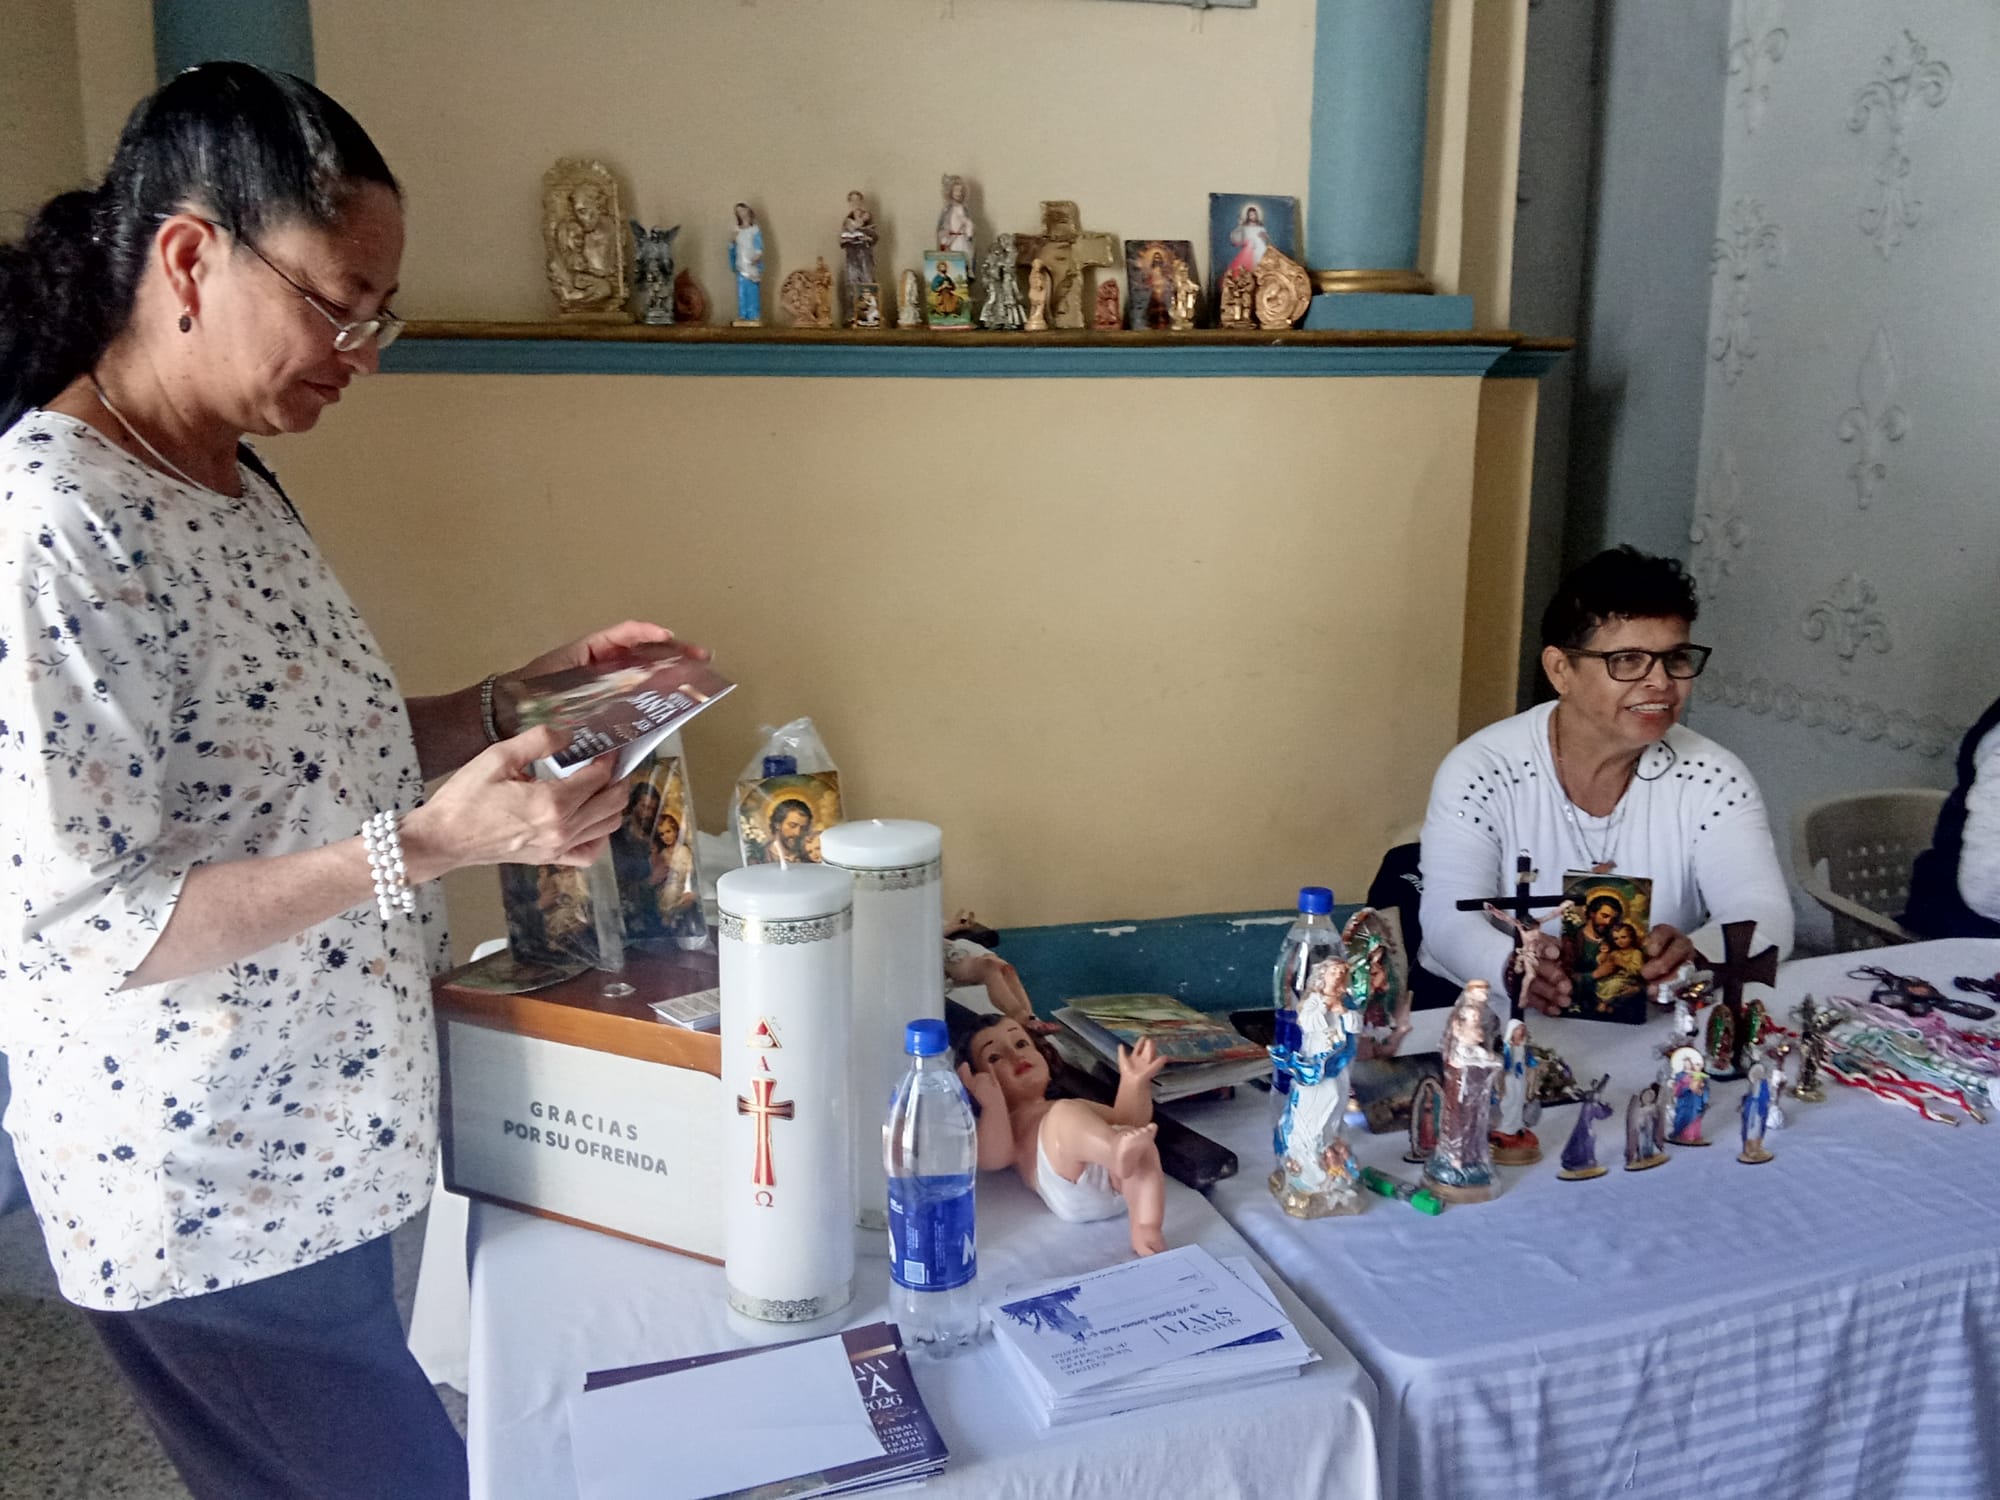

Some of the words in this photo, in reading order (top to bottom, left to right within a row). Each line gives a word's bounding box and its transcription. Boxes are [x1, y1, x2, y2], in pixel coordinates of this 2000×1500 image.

[530, 1101, 638, 1141] GRACIAS
[503, 1119, 541, 1143] POR
[545, 1130, 570, 1150] SU
[574, 1138, 668, 1176] OFRENDA
[1162, 1306, 1233, 1334] SANTA
